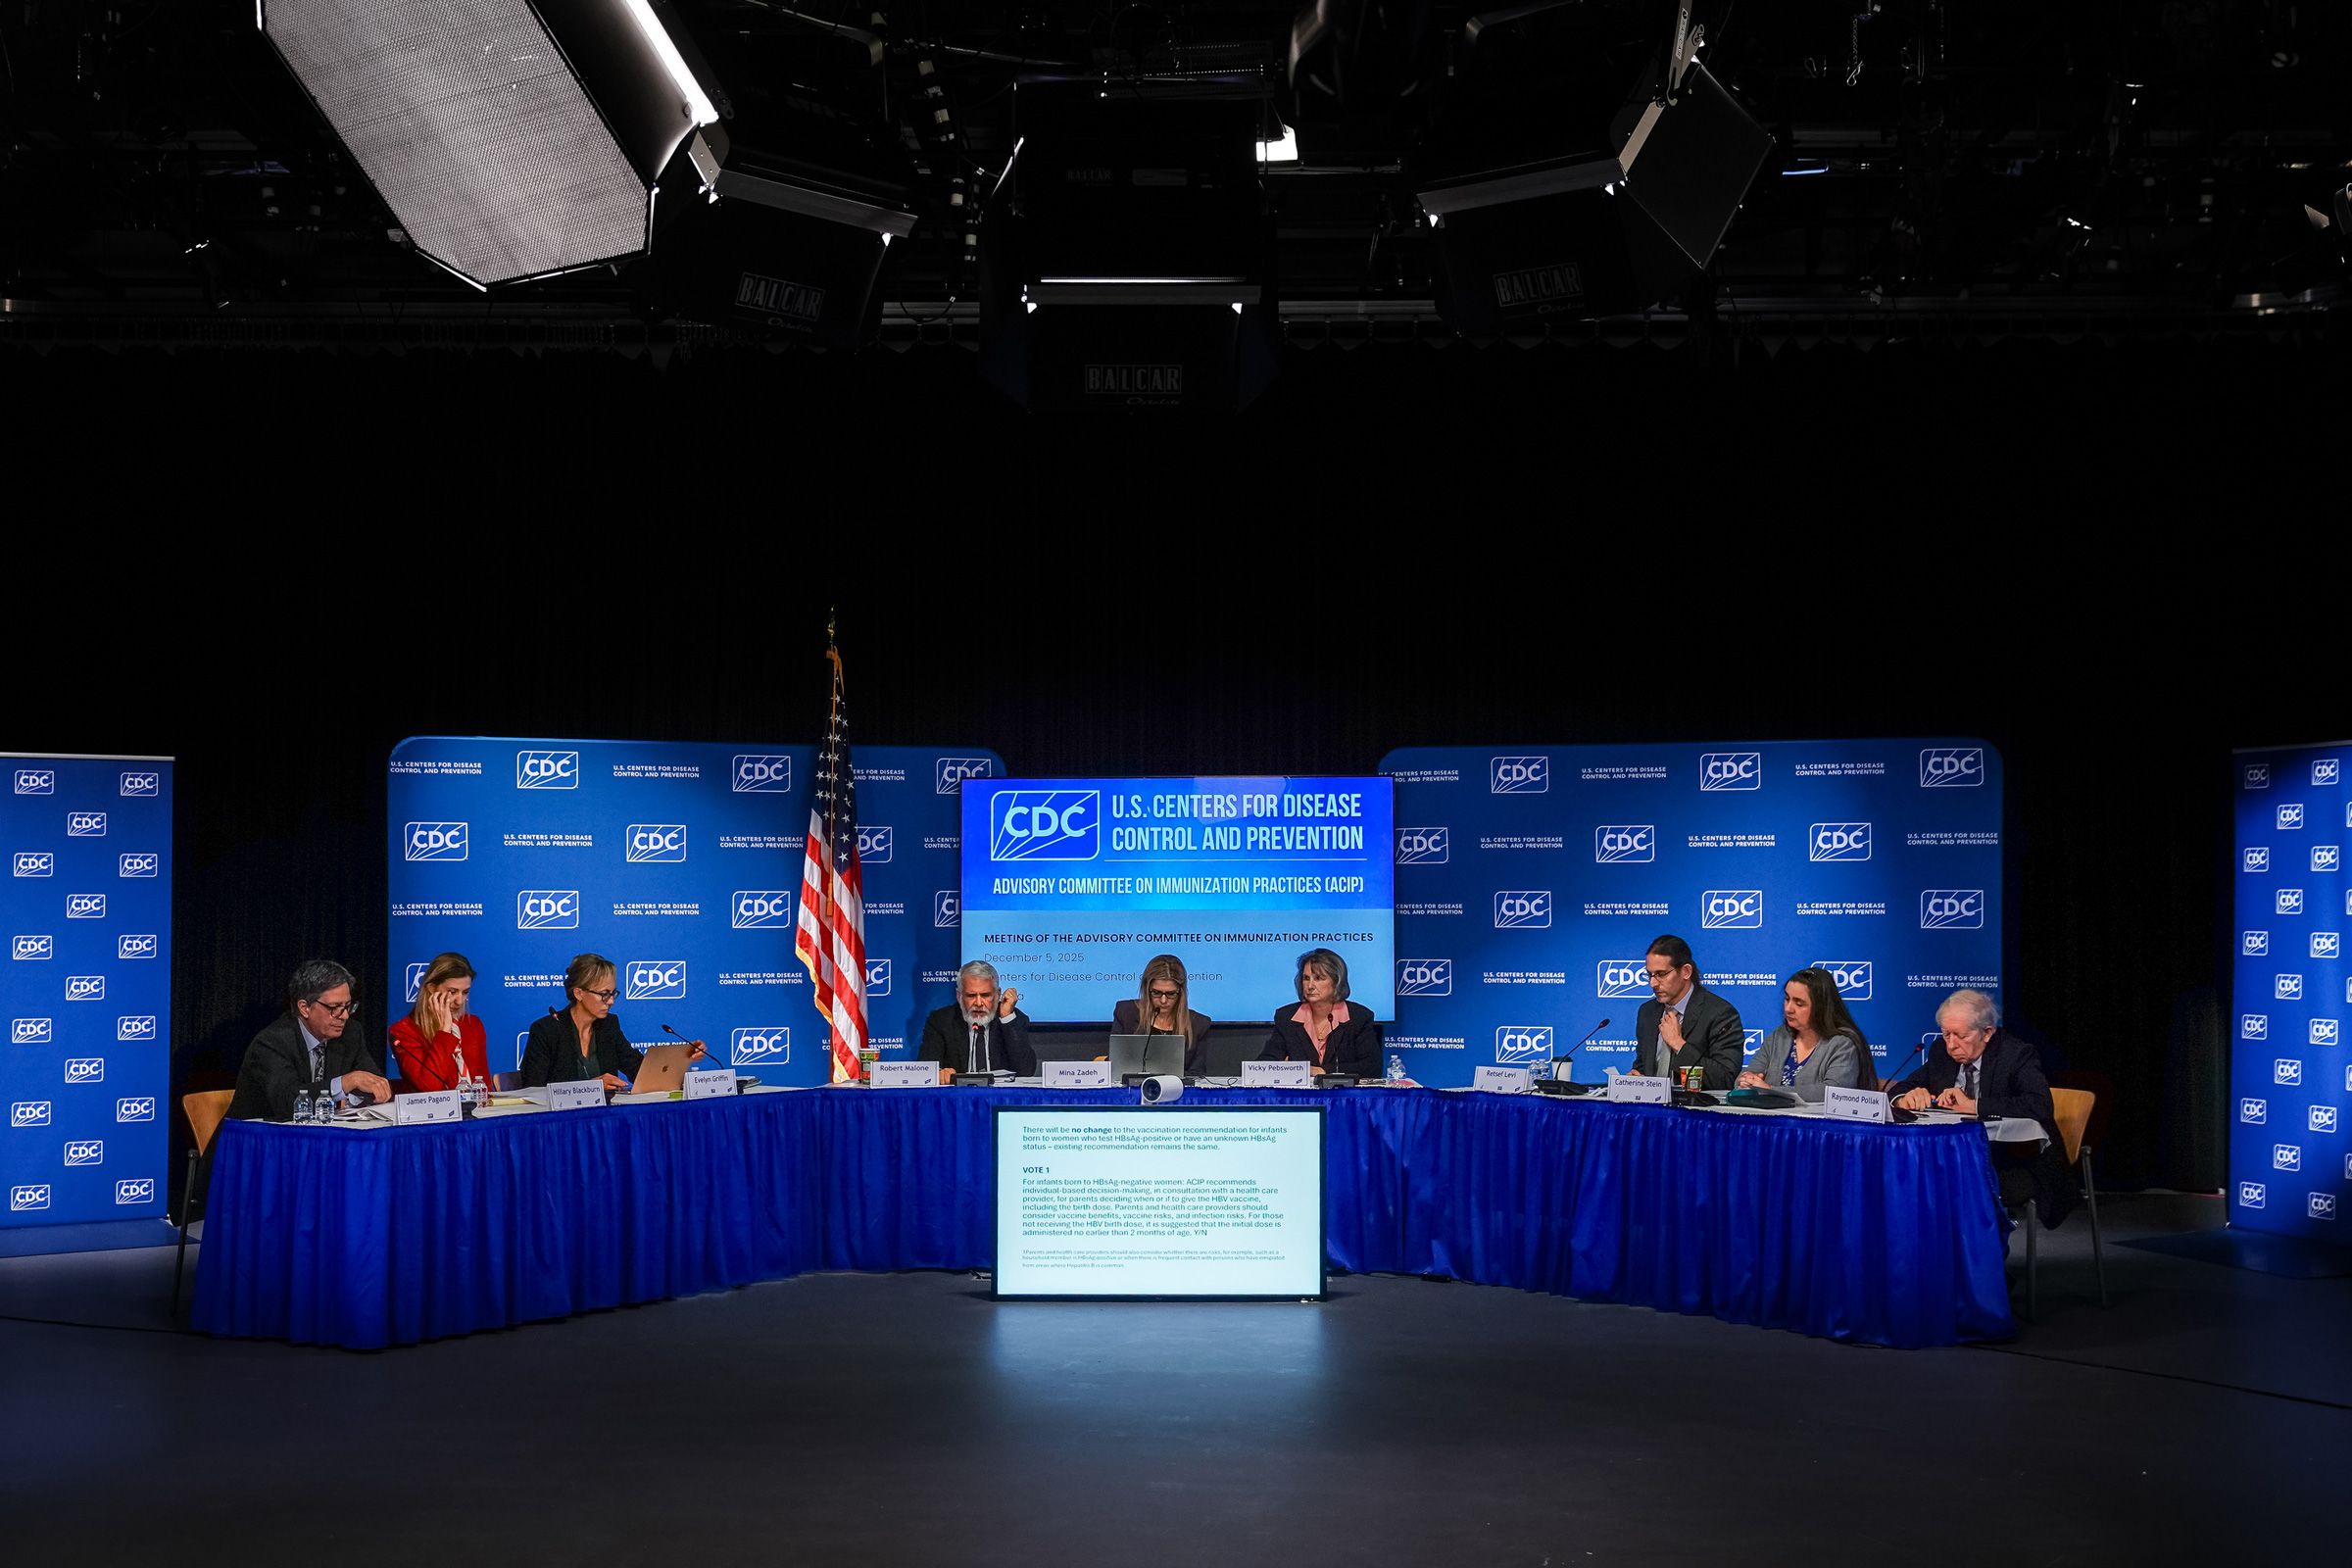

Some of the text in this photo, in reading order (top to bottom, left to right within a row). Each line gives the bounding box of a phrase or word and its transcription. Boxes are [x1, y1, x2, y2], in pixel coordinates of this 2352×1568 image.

[1497, 265, 1581, 304] BALCAR
[739, 276, 821, 318] BALCAR
[1088, 368, 1179, 391] BALCAR
[524, 759, 571, 777] CDC
[739, 762, 784, 780] CDC
[1707, 760, 1754, 779] CDC
[1929, 757, 1976, 775] CDC
[2315, 764, 2335, 777] CDC
[1497, 764, 1542, 782] CDC
[20, 775, 49, 787] CDC
[125, 777, 154, 789] CDC
[1112, 794, 1362, 818] U.S. CENTERS FOR DISEASE
[1004, 806, 1087, 838] CDC
[2279, 809, 2300, 822] CDC
[73, 817, 102, 829] CDC
[414, 830, 461, 849] CDC
[634, 833, 679, 851] CDC
[1112, 826, 1363, 851] CONTROL AND PREVENTION
[1399, 835, 1442, 853] CDC
[1603, 833, 1648, 852] CDC
[1817, 831, 1864, 850] CDC
[2246, 853, 2267, 864] CDC
[2314, 851, 2336, 863] CDC
[19, 858, 48, 870] CDC
[124, 858, 153, 870] CDC
[993, 876, 1364, 895] ADVISORY COMMITTEE ON IMMUNIZATION PRACTICES (ACIP)
[72, 899, 101, 910] CDC
[2279, 894, 2300, 906] CDC
[525, 899, 571, 917] CDC
[740, 899, 784, 917] CDC
[1501, 900, 1544, 916] CDC
[1709, 898, 1755, 916] CDC
[1929, 898, 1977, 917] CDC
[984, 933, 1374, 943] MEETING OF THE ADVISORY COMMITTEE ON IMMUNIZATION PRACTICES
[2245, 936, 2266, 949] CDC
[2313, 937, 2336, 951] CDC
[984, 953, 1085, 964] December 5, 2025
[633, 968, 679, 988] CDC
[998, 972, 1028, 982] nters
[1031, 971, 1046, 982] for
[1049, 972, 1092, 982] Disease
[1095, 972, 1137, 982] Control
[1187, 971, 1223, 981] ention
[1403, 966, 1445, 985] CDC
[1605, 968, 1649, 987] CDC
[2278, 980, 2299, 992] CDC
[739, 1036, 783, 1054] CDC
[1503, 1034, 1546, 1052] CDC
[71, 1063, 99, 1075] CDC
[1248, 1064, 1266, 1073] Vicky
[1504, 1070, 1517, 1079] Levi
[694, 1074, 729, 1085] Evelyn Griffin
[1615, 1078, 1645, 1088] Catherine
[553, 1086, 601, 1096] Hillary Blackburn
[406, 1094, 451, 1105] James Pagano
[1831, 1092, 1880, 1105] Raymond Pollak
[17, 1106, 46, 1119] CDC
[122, 1102, 150, 1114] CDC
[1083, 1126, 1112, 1135] change
[1114, 1135, 1173, 1144] HBsAg-positive
[1250, 1135, 1277, 1144] HBsAg
[70, 1146, 98, 1158] CDC
[1054, 1143, 1083, 1152] existing
[1093, 1178, 1152, 1187] HBsAg-negative
